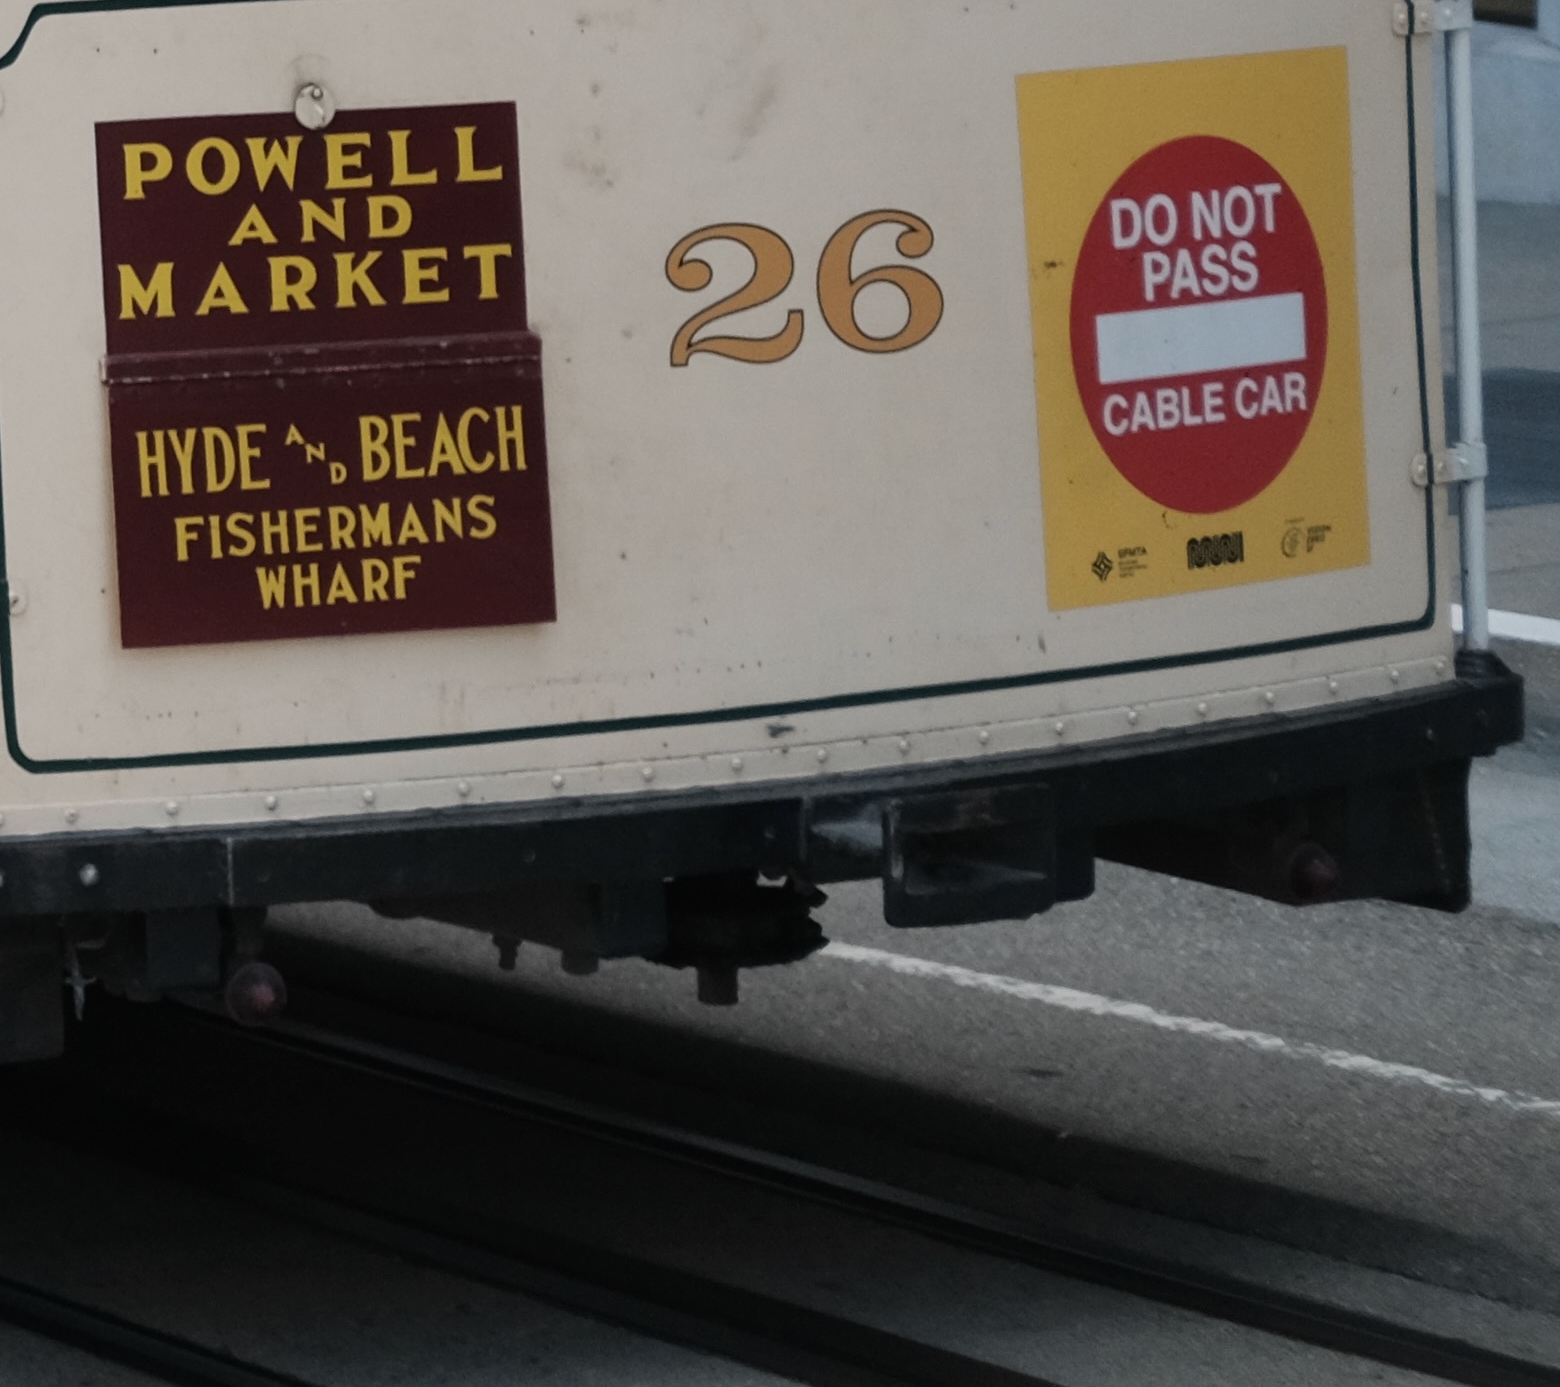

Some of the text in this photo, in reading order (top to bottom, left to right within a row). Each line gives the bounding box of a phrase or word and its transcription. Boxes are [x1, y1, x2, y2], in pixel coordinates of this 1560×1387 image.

[123, 125, 504, 200] POWELL
[229, 193, 414, 246] AND
[1110, 181, 1282, 251] DO NOT
[118, 243, 513, 321] MARKET
[664, 208, 945, 367] 26
[1142, 240, 1260, 302] PASS
[1102, 370, 1308, 436] CABLE CAR
[136, 404, 528, 499] HYDE AND BEACH
[174, 494, 498, 562] FISHERMANS
[256, 555, 422, 610] WHARF
